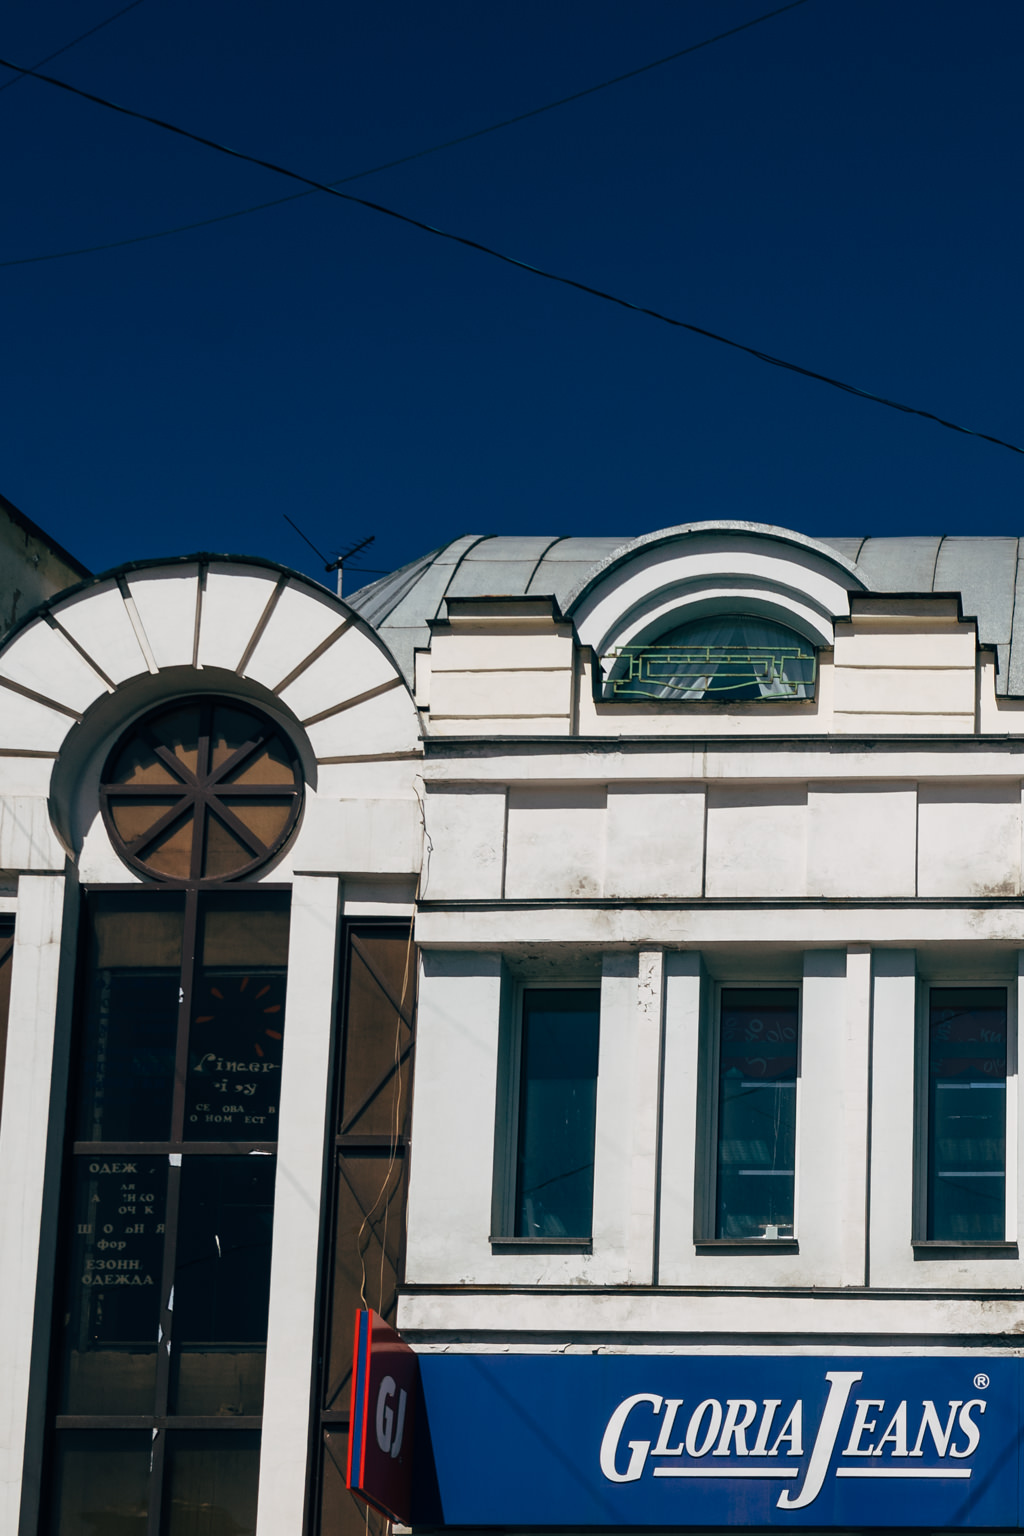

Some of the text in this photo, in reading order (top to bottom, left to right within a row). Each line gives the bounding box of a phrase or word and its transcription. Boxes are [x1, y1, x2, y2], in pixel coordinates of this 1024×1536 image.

[89, 1162, 140, 1175] ОДЕЖ
[97, 1238, 127, 1251] фор
[81, 1274, 155, 1286] ОДЕЖДА
[375, 1375, 408, 1459] GJ
[600, 1371, 987, 1510] GLORIA JEANS
